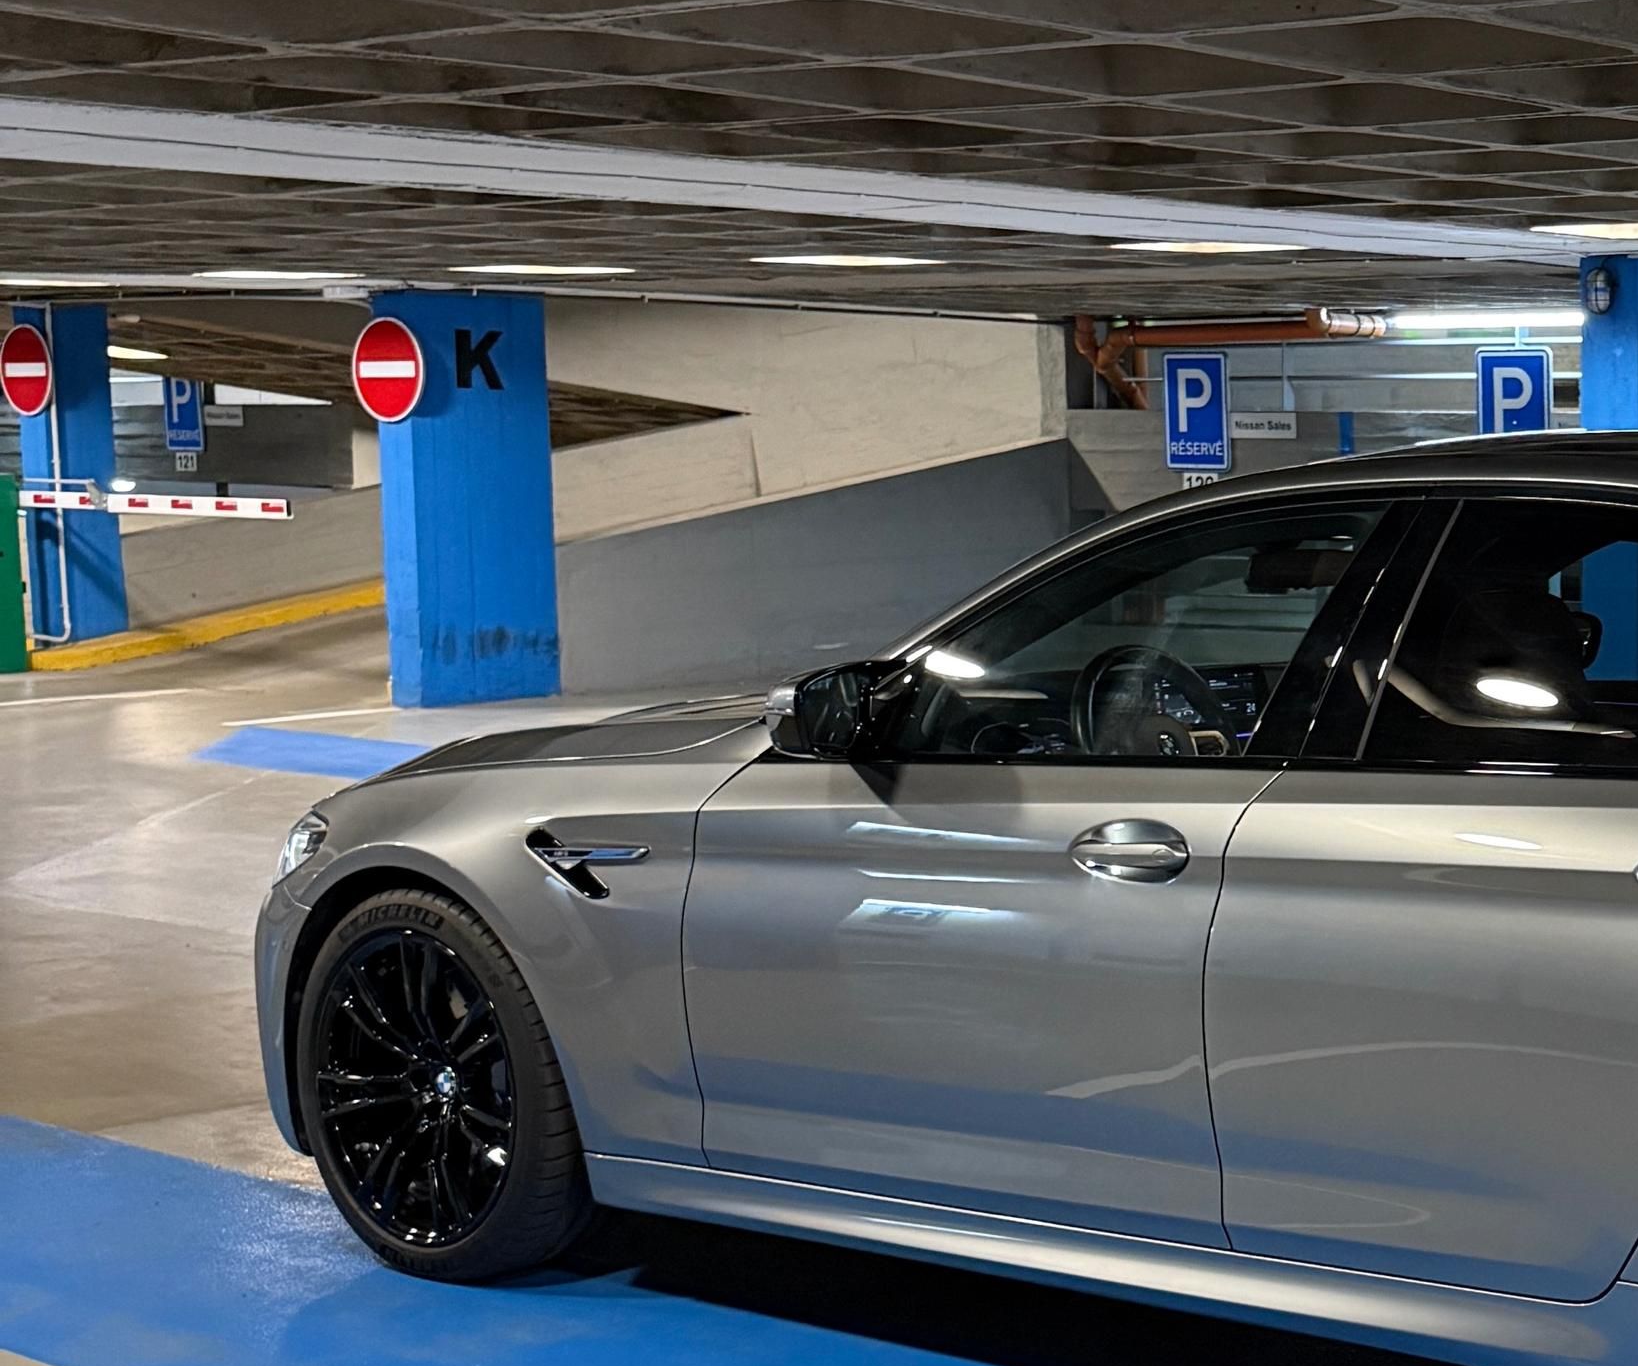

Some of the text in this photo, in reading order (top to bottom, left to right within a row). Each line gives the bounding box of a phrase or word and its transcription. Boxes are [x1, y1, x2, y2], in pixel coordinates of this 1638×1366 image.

[455, 328, 503, 391] K
[170, 377, 192, 423] P
[1176, 368, 1212, 433] P
[1493, 366, 1533, 434] P
[1170, 438, 1224, 456] RÉSERVÉ
[1235, 420, 1292, 432] Nissan Sales
[178, 455, 194, 469] 121
